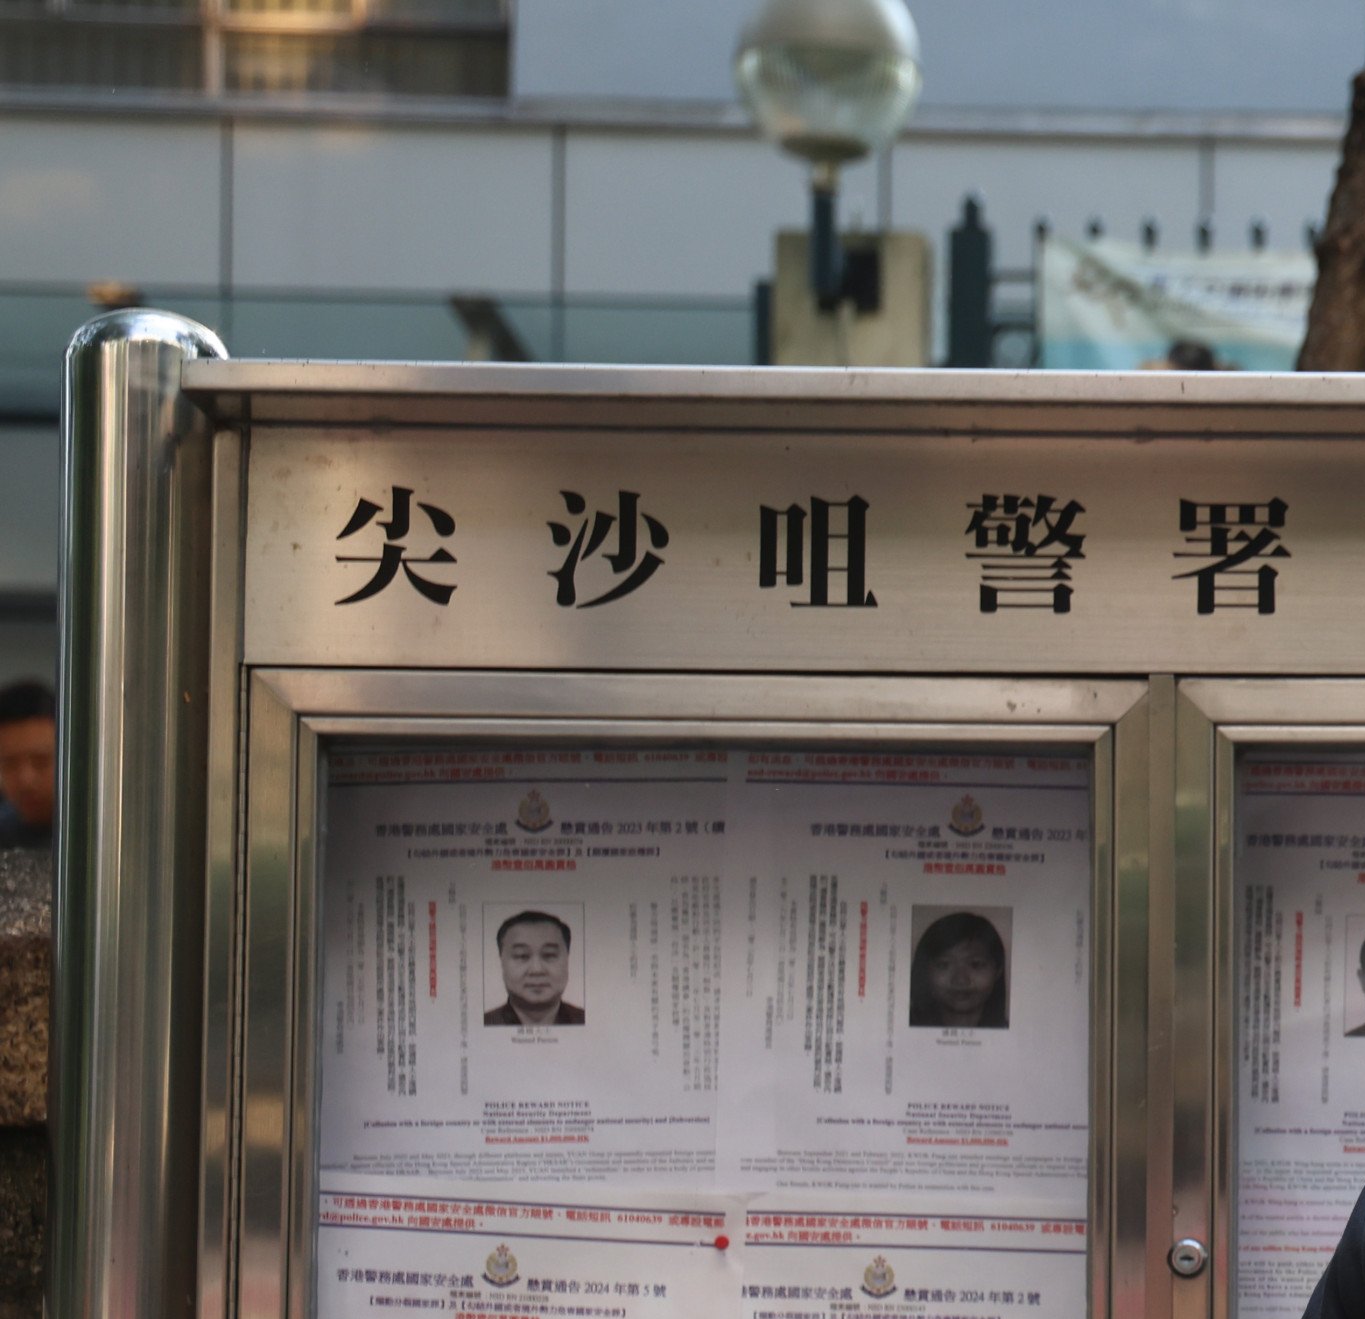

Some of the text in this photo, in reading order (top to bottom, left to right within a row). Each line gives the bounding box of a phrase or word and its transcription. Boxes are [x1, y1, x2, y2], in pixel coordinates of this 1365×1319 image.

[336, 486, 1292, 615] 尖沙咀警署
[337, 1267, 474, 1286] 香港警務處國家安全處
[584, 1282, 609, 1294] 2024
[960, 1291, 985, 1303] 2024
